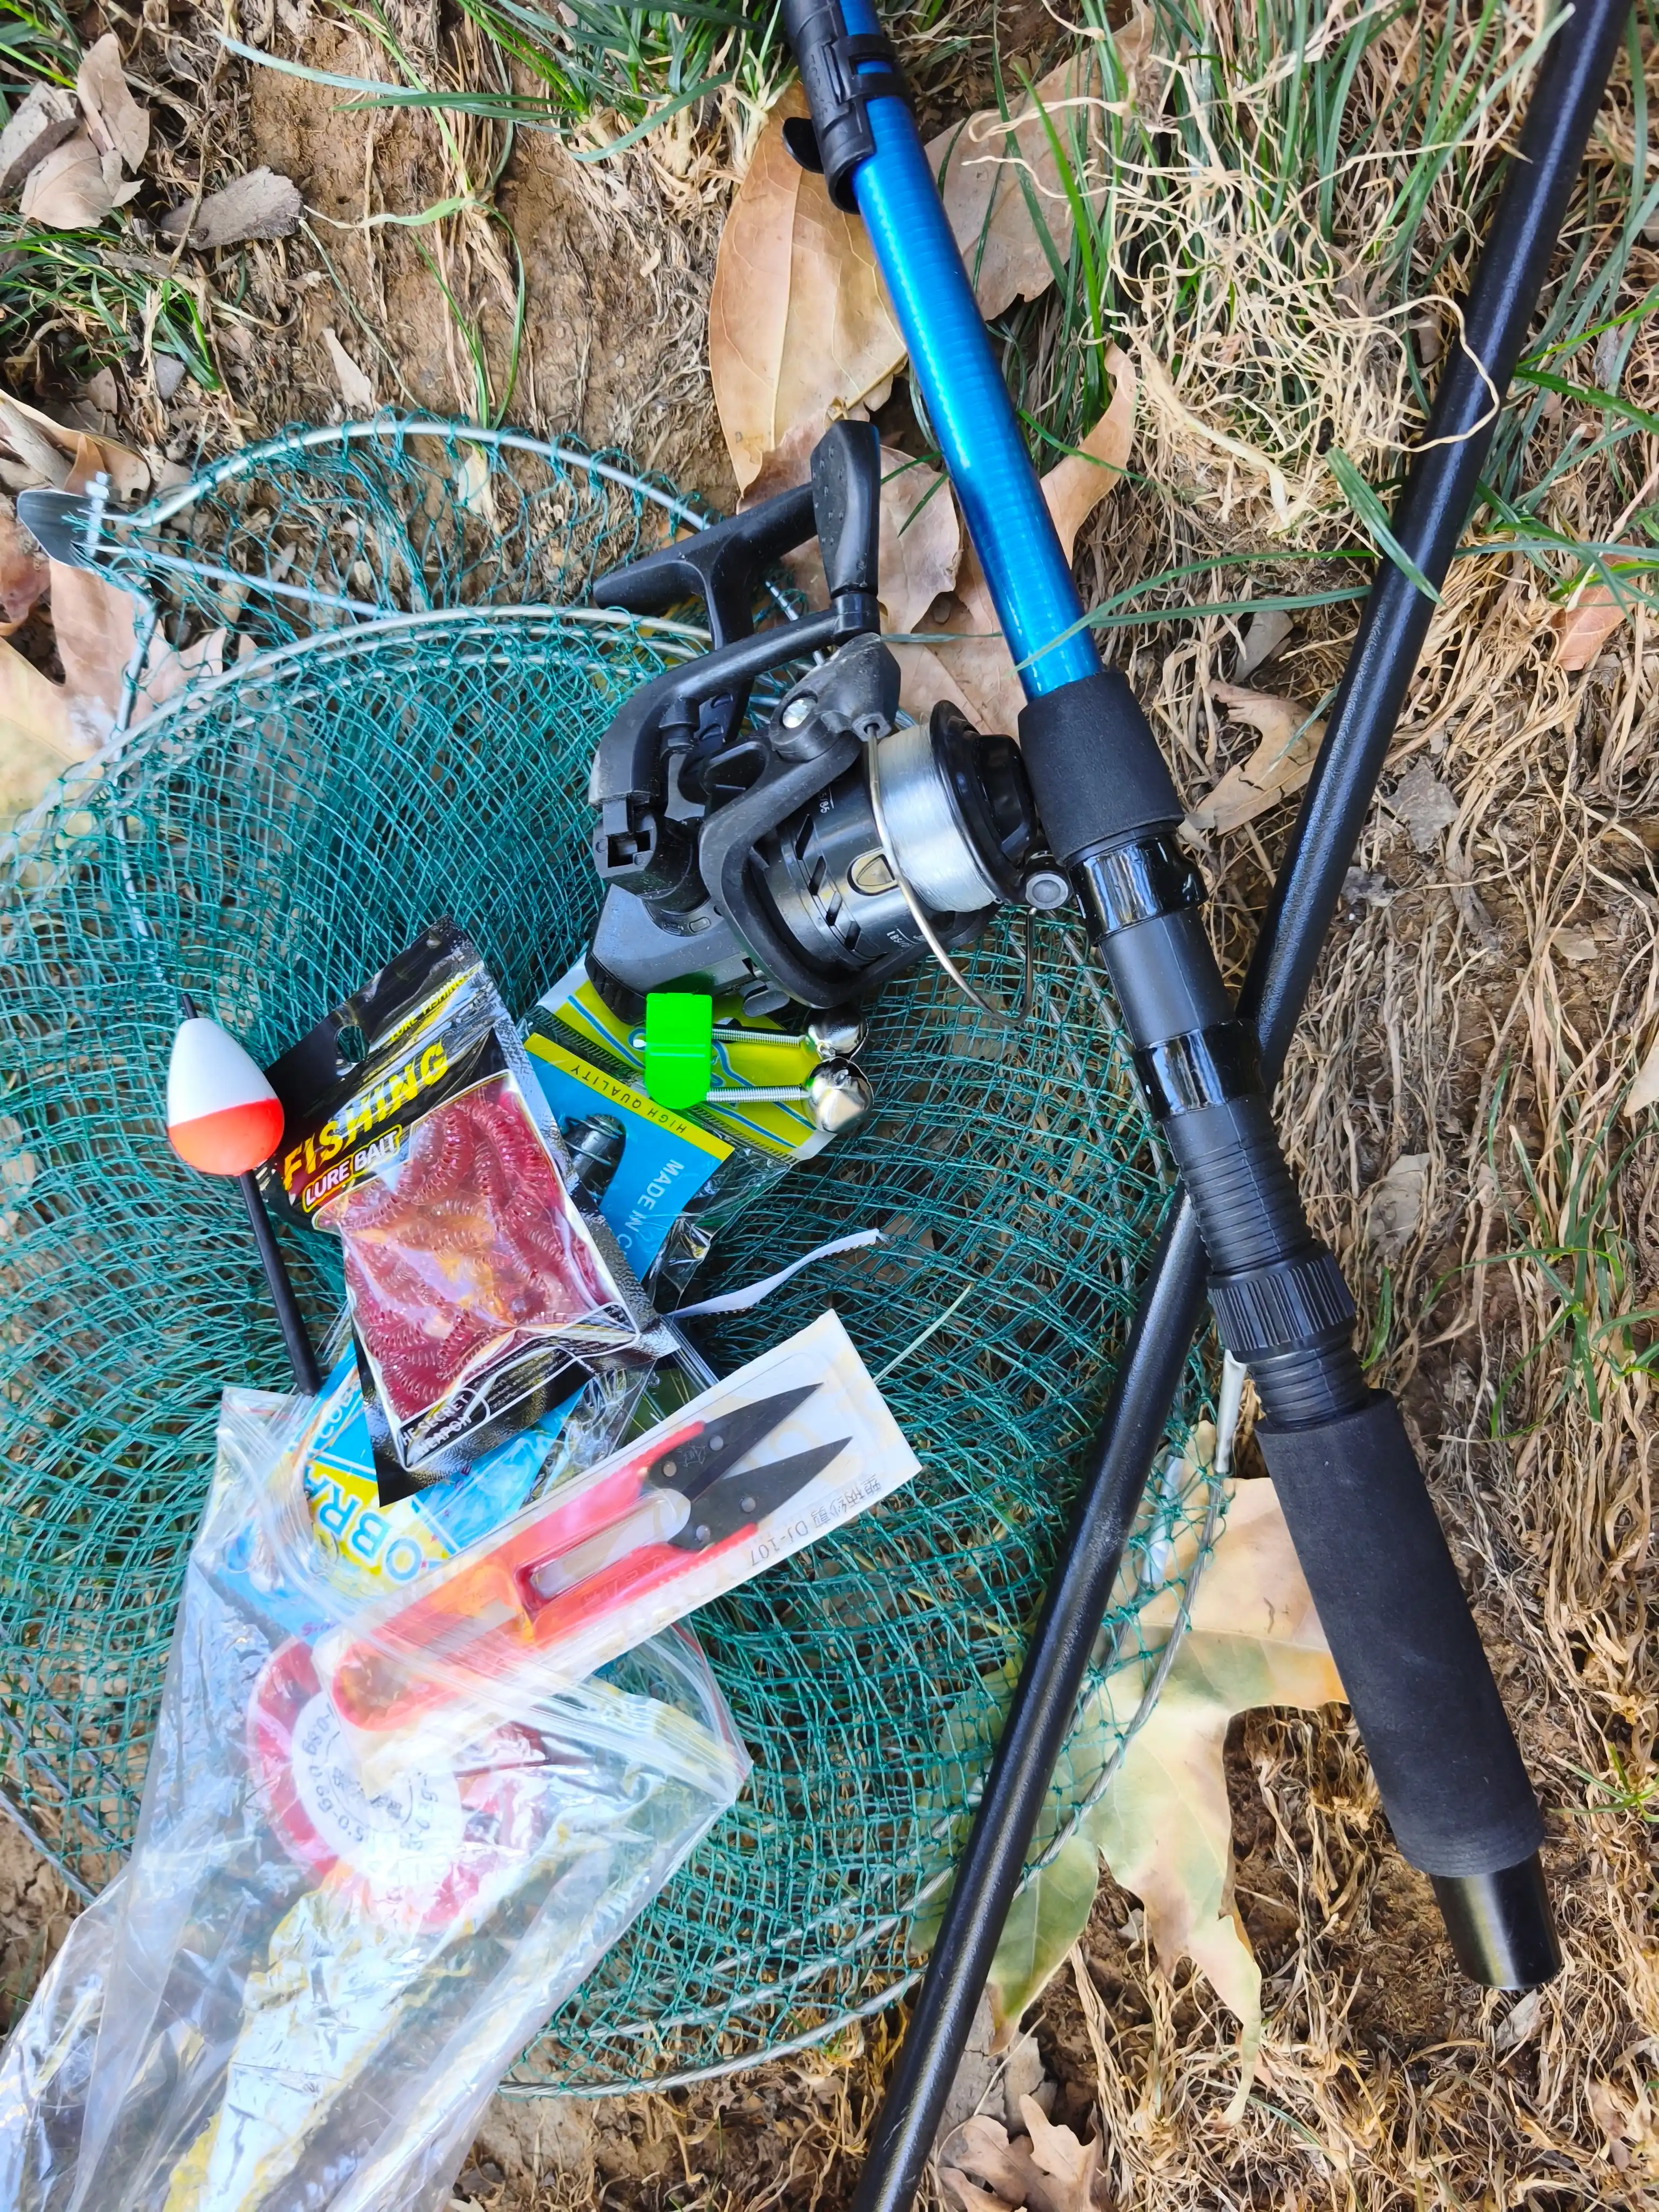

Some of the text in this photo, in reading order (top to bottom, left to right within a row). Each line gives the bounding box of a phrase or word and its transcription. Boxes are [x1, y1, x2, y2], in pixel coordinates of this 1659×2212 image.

[421, 973, 466, 1015] FISHING
[284, 1038, 448, 1191] FISHING
[570, 1064, 687, 1134] HIGH QUALITY
[306, 1130, 398, 1206] LURE BAIT
[637, 1159, 685, 1210] MADE
[415, 1414, 473, 1455] WEAPON
[417, 1393, 469, 1434] SECRET
[751, 1520, 809, 1567] DJ-107
